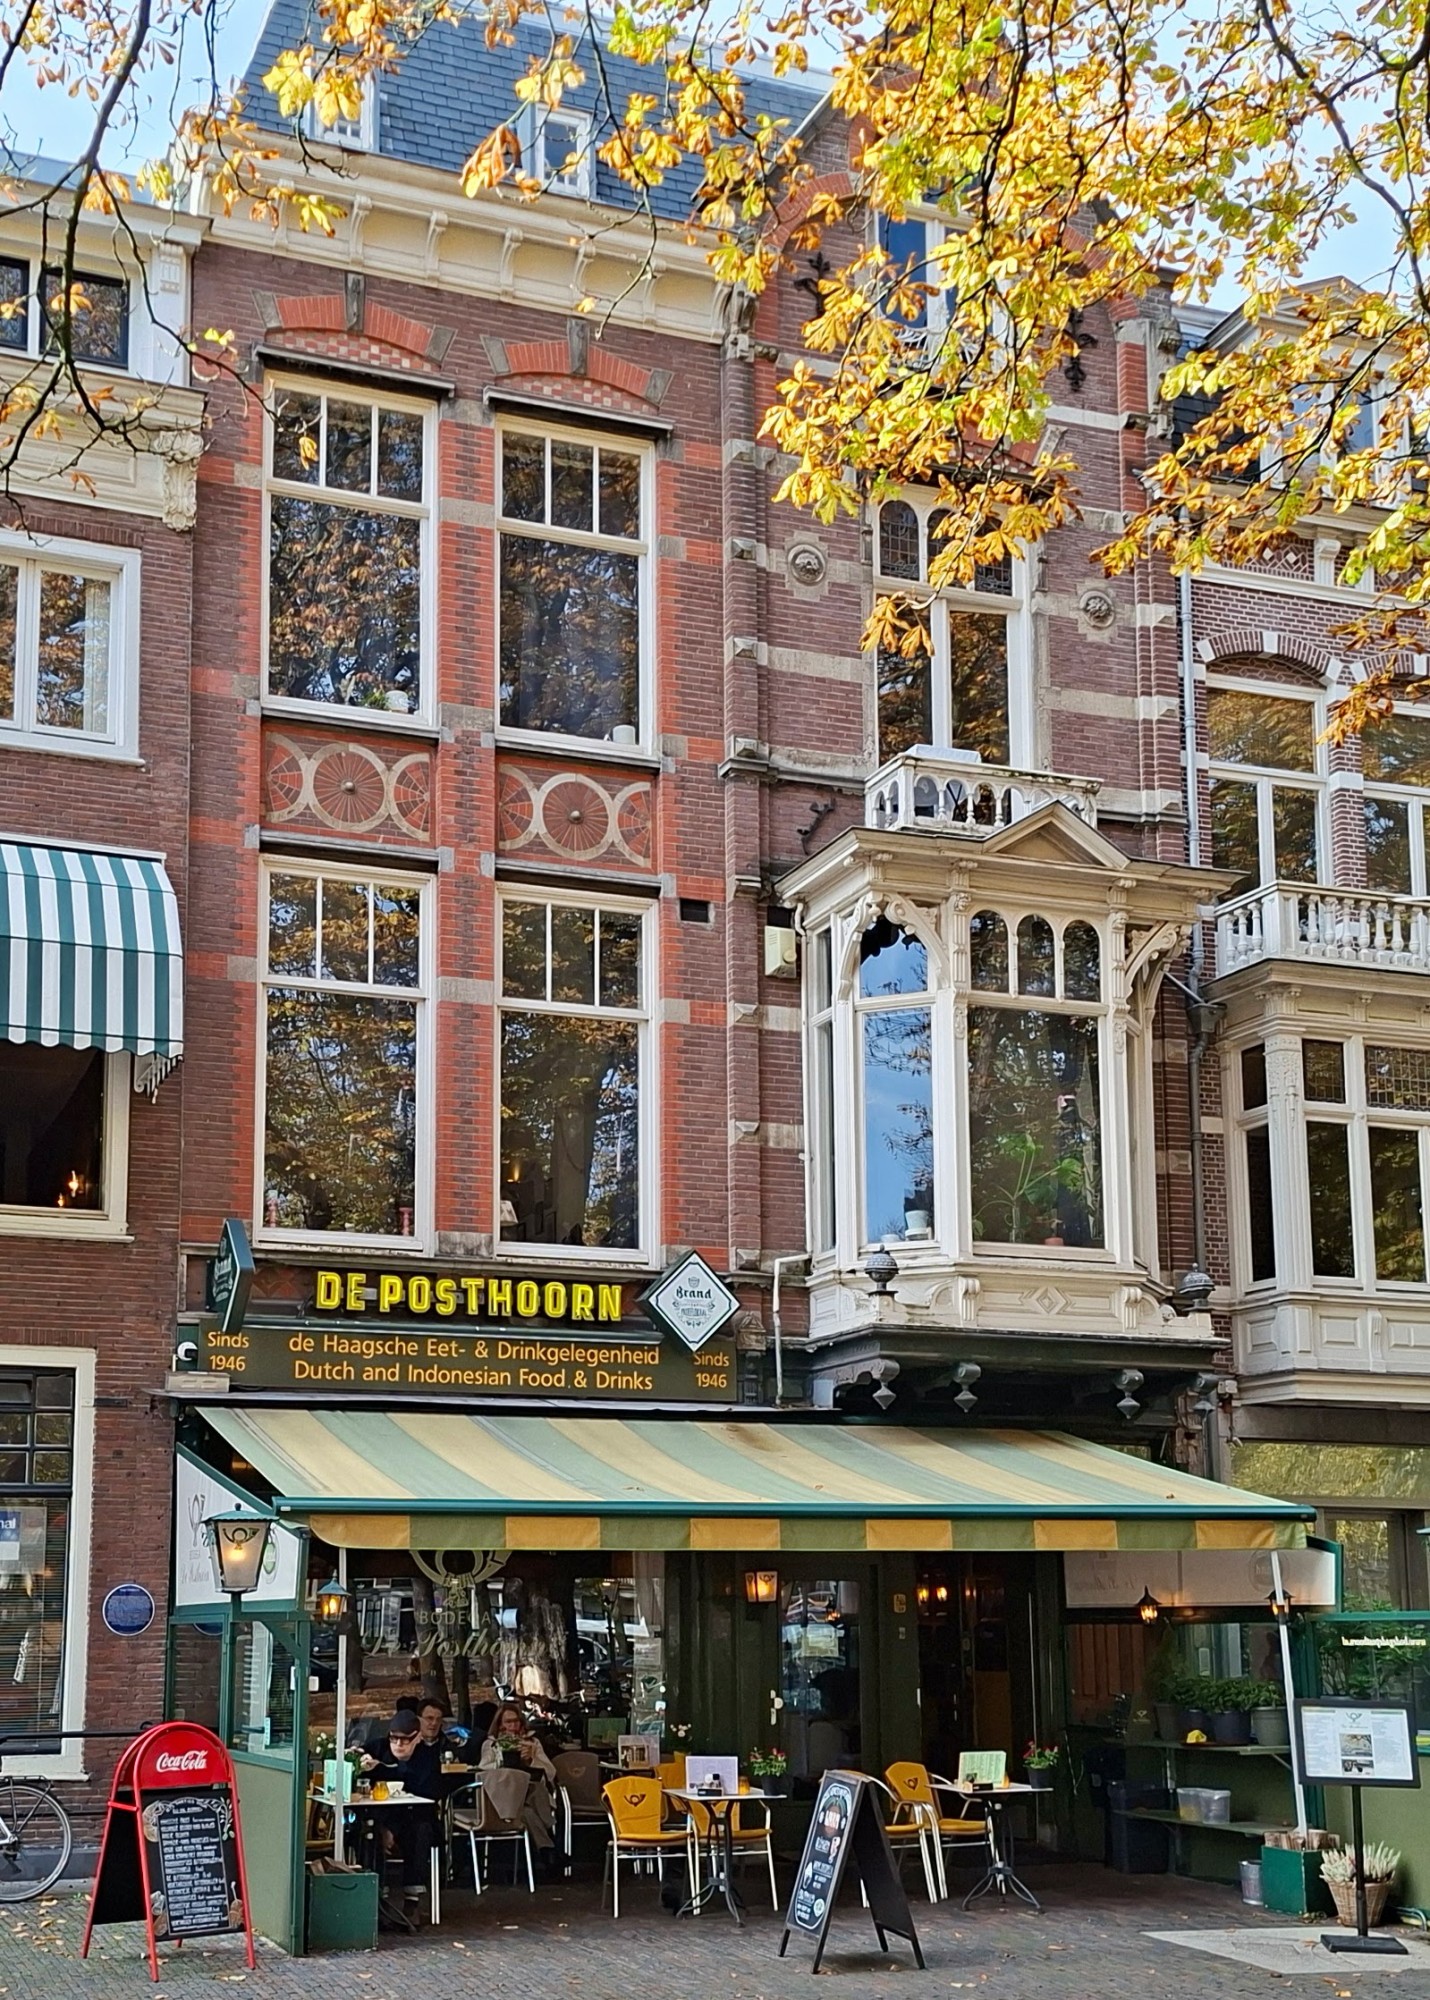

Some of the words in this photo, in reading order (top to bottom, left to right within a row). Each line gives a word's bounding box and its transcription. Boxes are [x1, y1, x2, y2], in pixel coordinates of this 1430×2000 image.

[316, 1270, 366, 1311] DE
[379, 1274, 623, 1322] POSTHOORN
[676, 1286, 712, 1299] Brand
[207, 1331, 249, 1348] Sinds
[289, 1333, 315, 1352] de
[323, 1334, 418, 1359] Haagsche
[427, 1338, 466, 1357] Eet-
[474, 1341, 489, 1359] &
[498, 1341, 660, 1366] Drinkgelegenheid
[209, 1355, 246, 1371] 1946
[693, 1350, 730, 1367] Sinds
[294, 1360, 354, 1380] Dutch
[362, 1363, 400, 1382] and
[408, 1365, 512, 1386] Indonesian
[519, 1368, 566, 1387] Food
[573, 1371, 588, 1388] &
[596, 1371, 653, 1390] Drinks
[695, 1373, 727, 1388] 1946
[419, 1610, 492, 1625] BODEA
[156, 1750, 208, 1773] Coca-Cola
